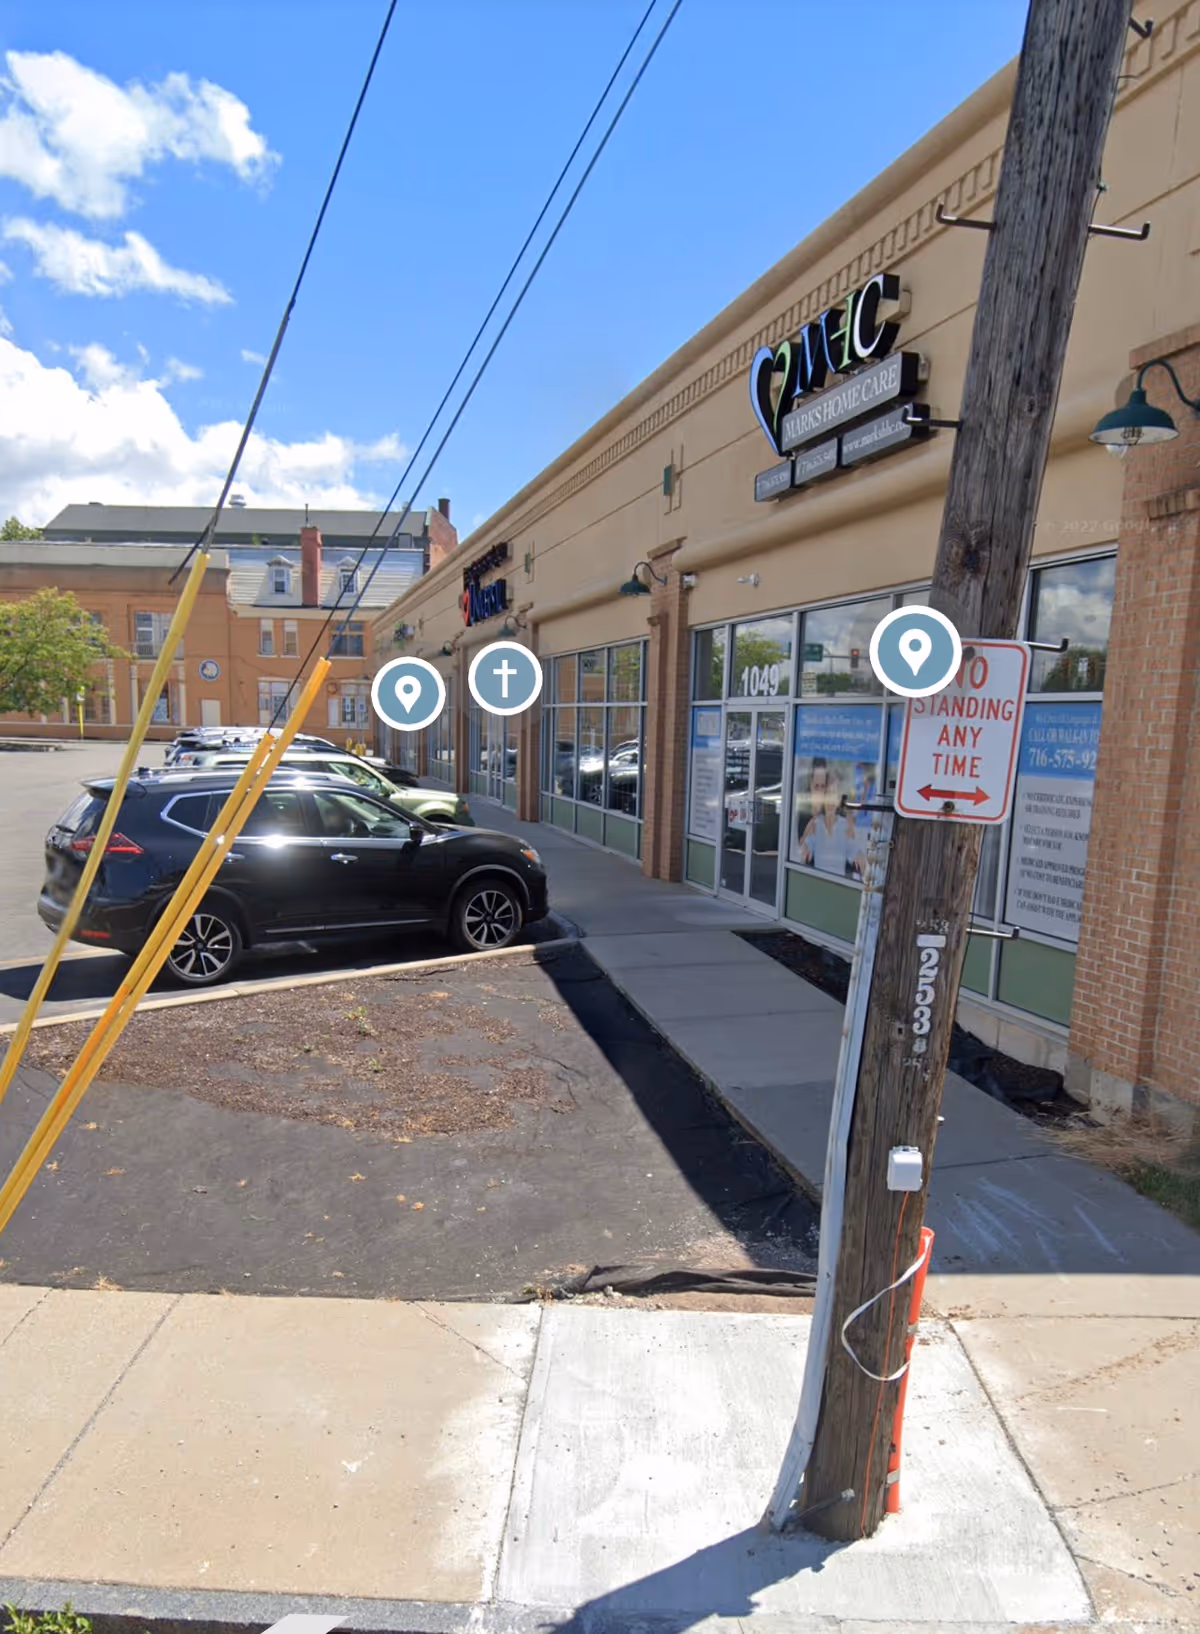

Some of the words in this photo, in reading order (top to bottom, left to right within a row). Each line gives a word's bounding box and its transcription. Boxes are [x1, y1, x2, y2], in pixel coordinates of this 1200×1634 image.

[793, 273, 892, 398] MHC
[822, 384, 860, 424] HOME
[862, 364, 898, 402] CARE
[741, 664, 780, 697] 1049
[914, 695, 1015, 722] STANDING
[937, 725, 983, 749] ANY
[932, 753, 983, 778] TIME
